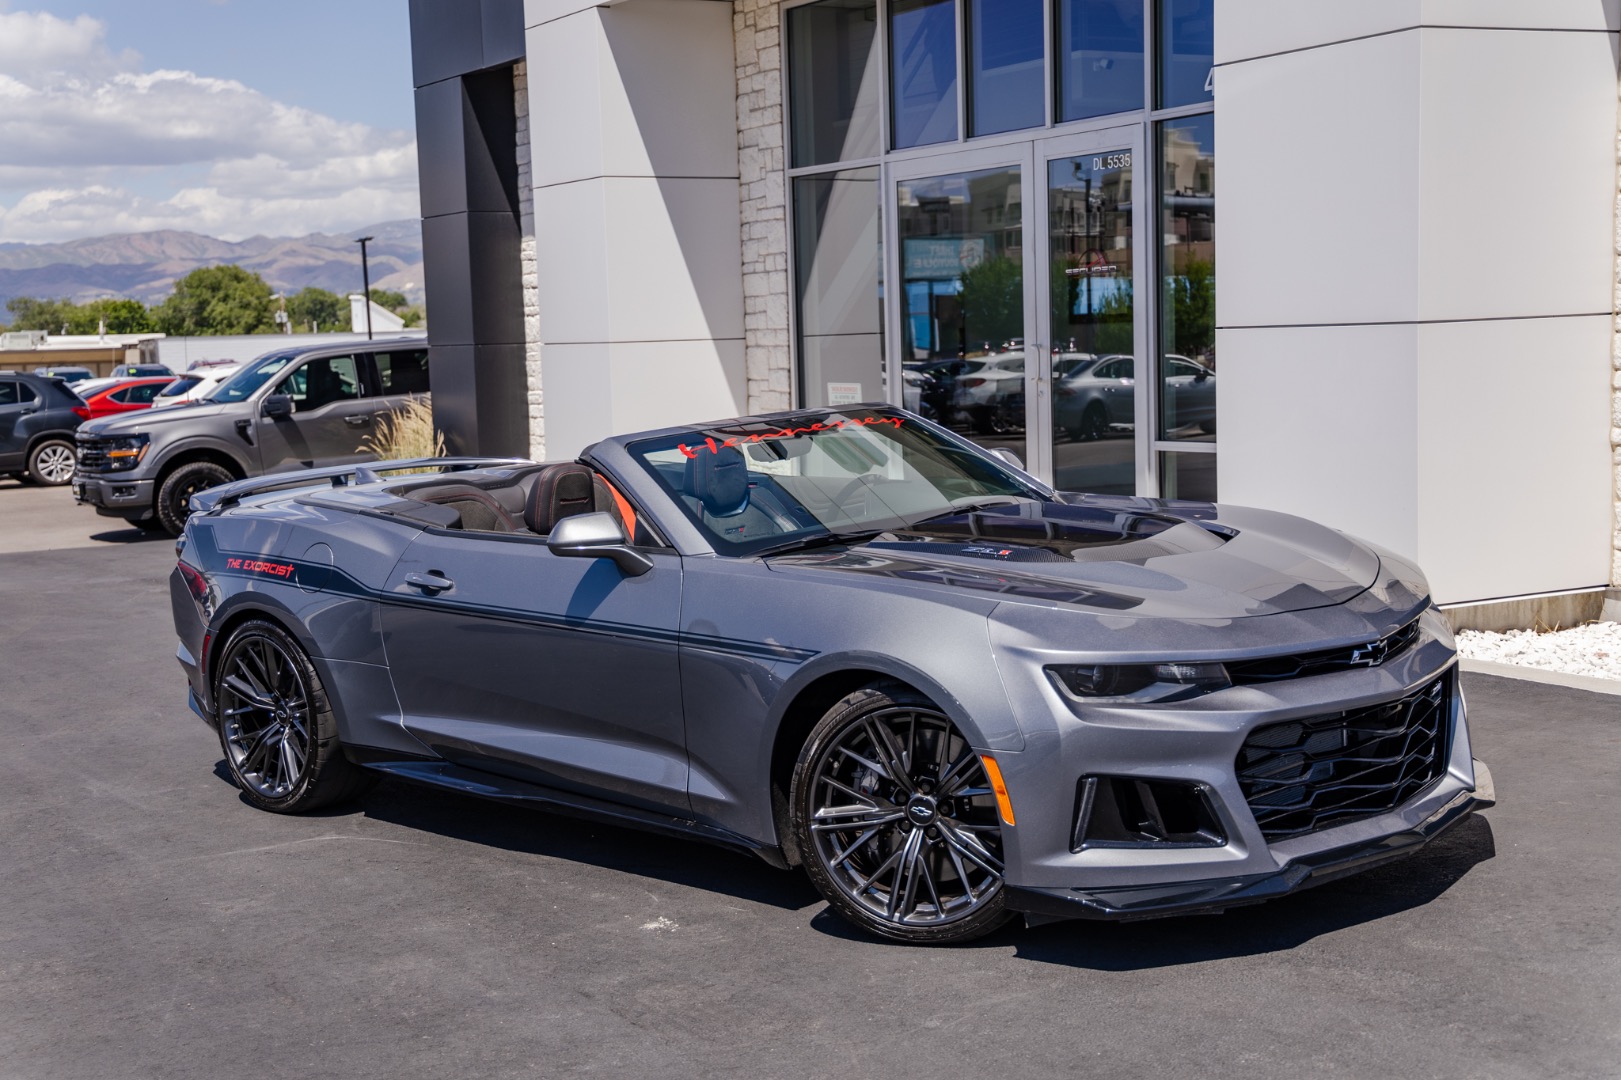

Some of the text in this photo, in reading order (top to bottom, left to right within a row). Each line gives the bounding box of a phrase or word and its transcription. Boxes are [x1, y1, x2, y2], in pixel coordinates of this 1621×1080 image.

[1093, 153, 1131, 171] DL 5535
[678, 416, 904, 459] Hennessey
[226, 558, 295, 579] THE EXORCIST
